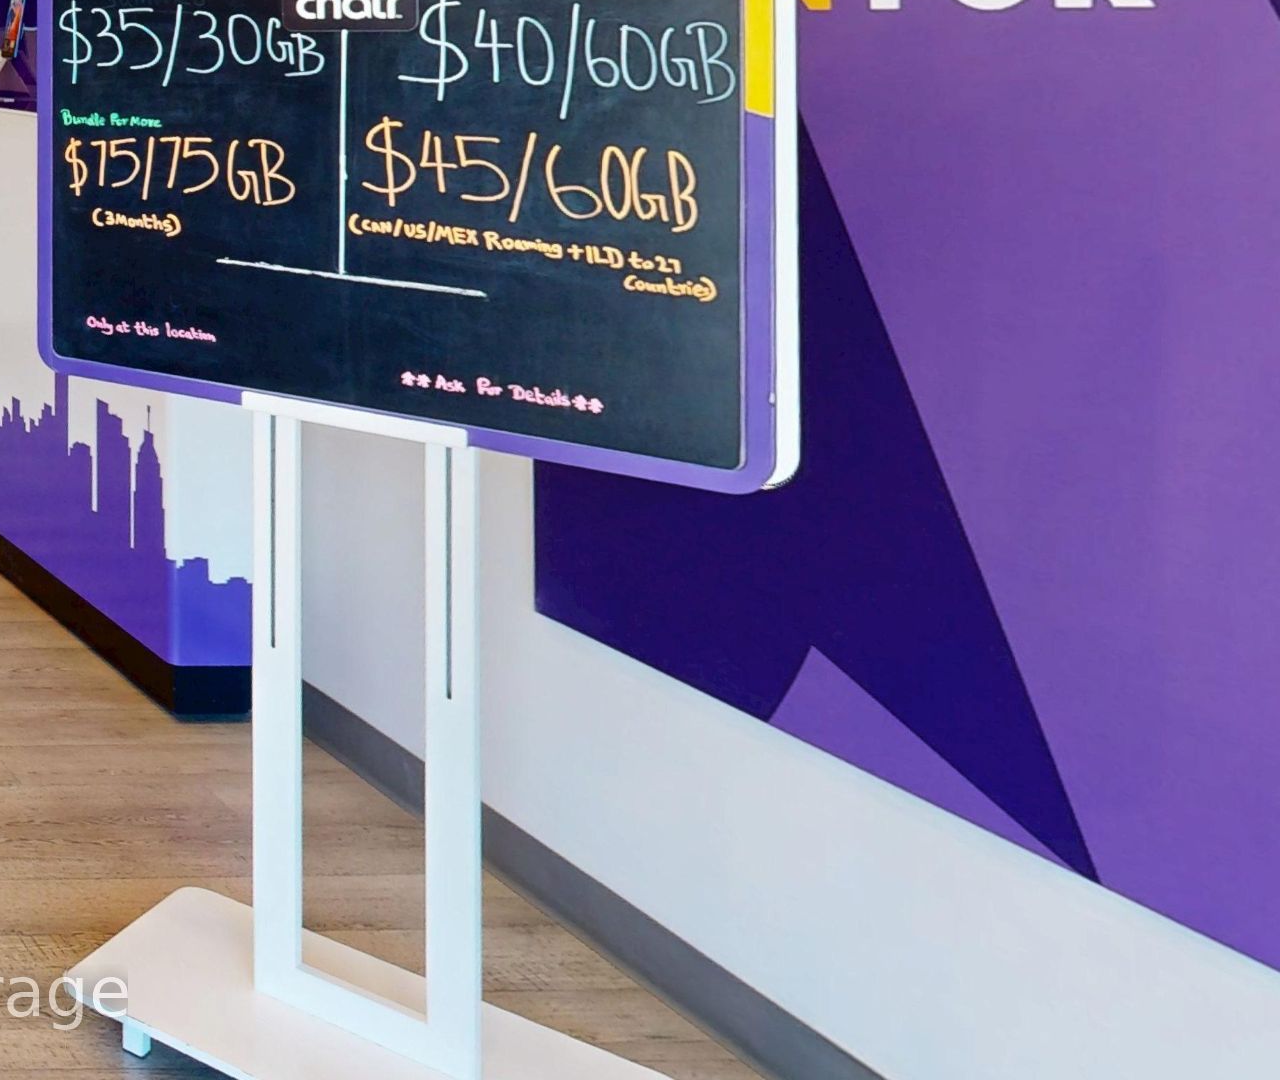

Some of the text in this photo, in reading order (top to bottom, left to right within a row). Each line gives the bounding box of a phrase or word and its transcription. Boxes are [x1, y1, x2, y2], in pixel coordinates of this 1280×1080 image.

[59, 0, 326, 87] $35/30GB
[60, 108, 106, 127] Bundle
[362, 116, 699, 233] $45/60GB
[483, 231, 564, 260] Roaming
[86, 316, 217, 343] Only at this location
[435, 374, 466, 393] Ask
